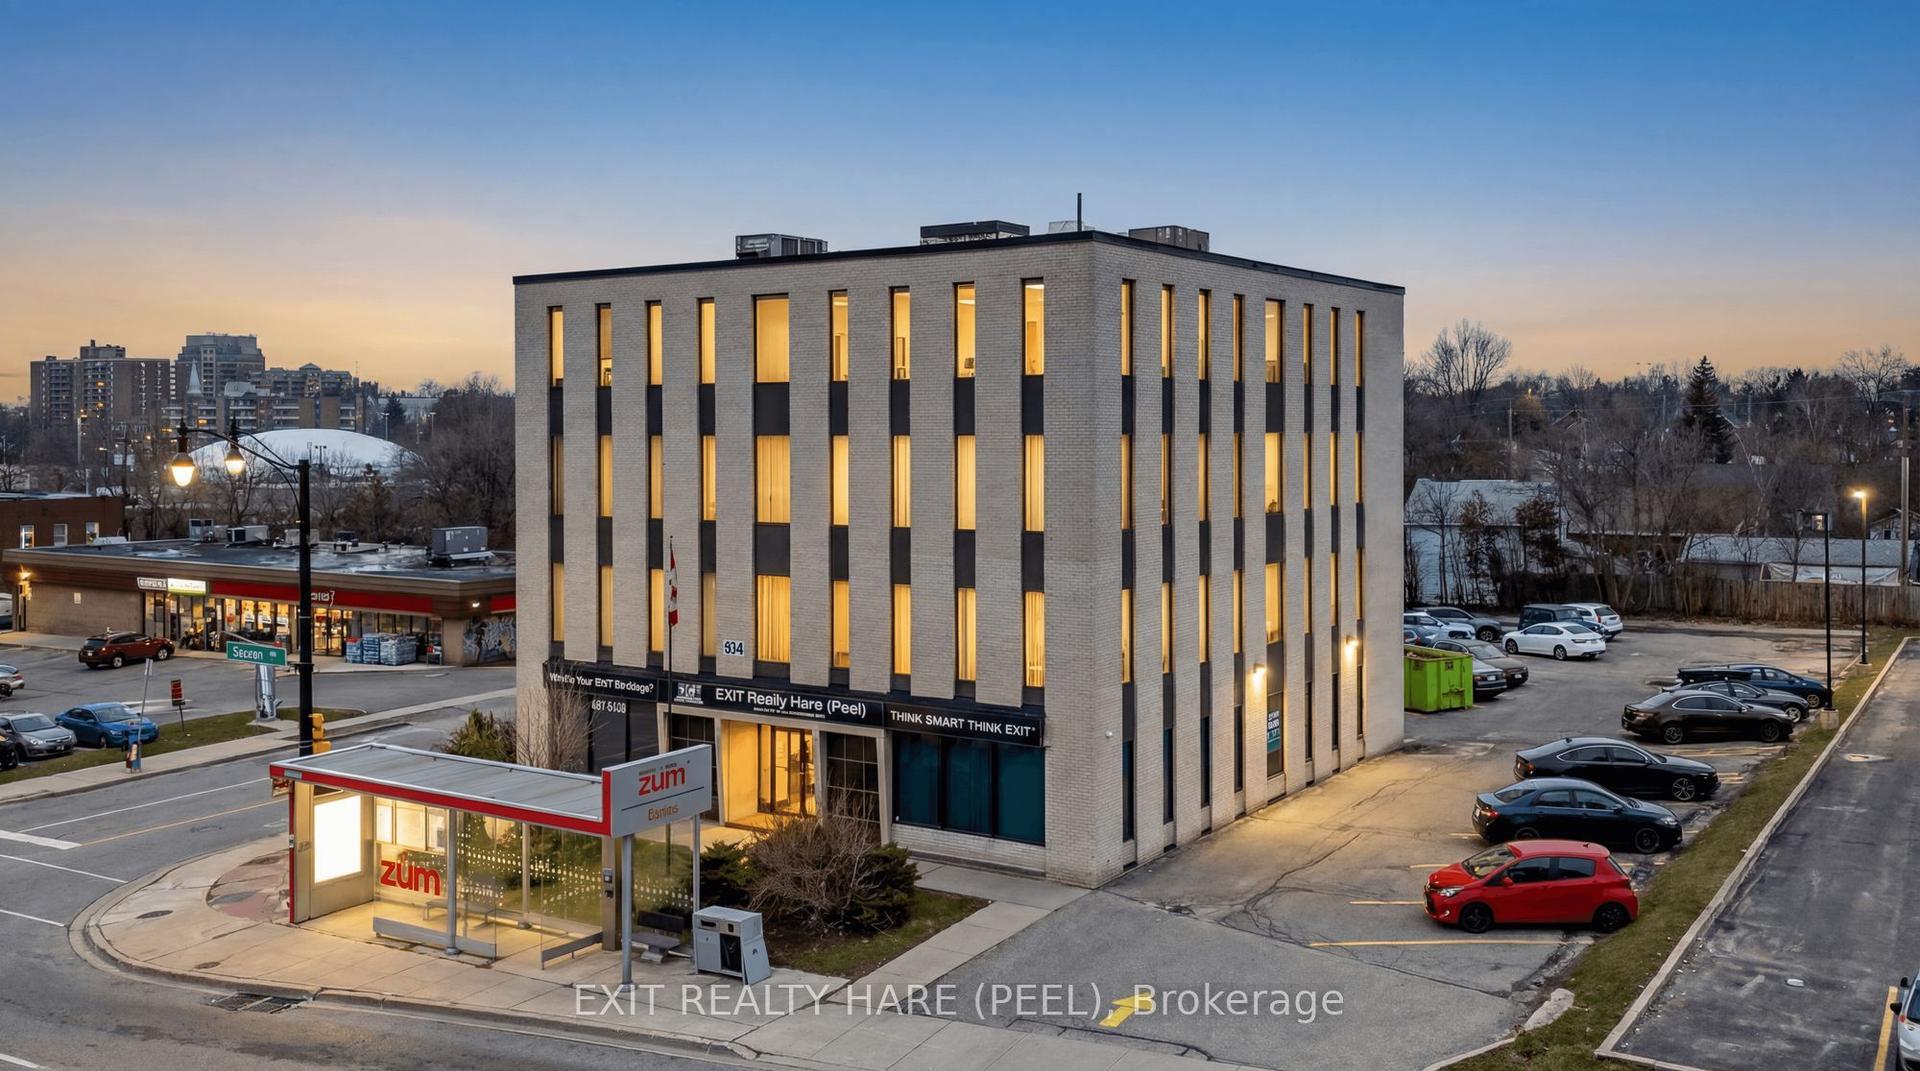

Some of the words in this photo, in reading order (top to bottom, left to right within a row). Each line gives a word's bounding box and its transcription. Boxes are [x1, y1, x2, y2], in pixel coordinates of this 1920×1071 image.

[576, 676, 594, 686] Your
[715, 687, 745, 702] EXIT
[790, 695, 823, 711] Hare
[827, 699, 866, 719] (Peel)
[890, 710, 923, 724] THINK
[925, 714, 965, 729] SMART
[968, 719, 1002, 734] THINK
